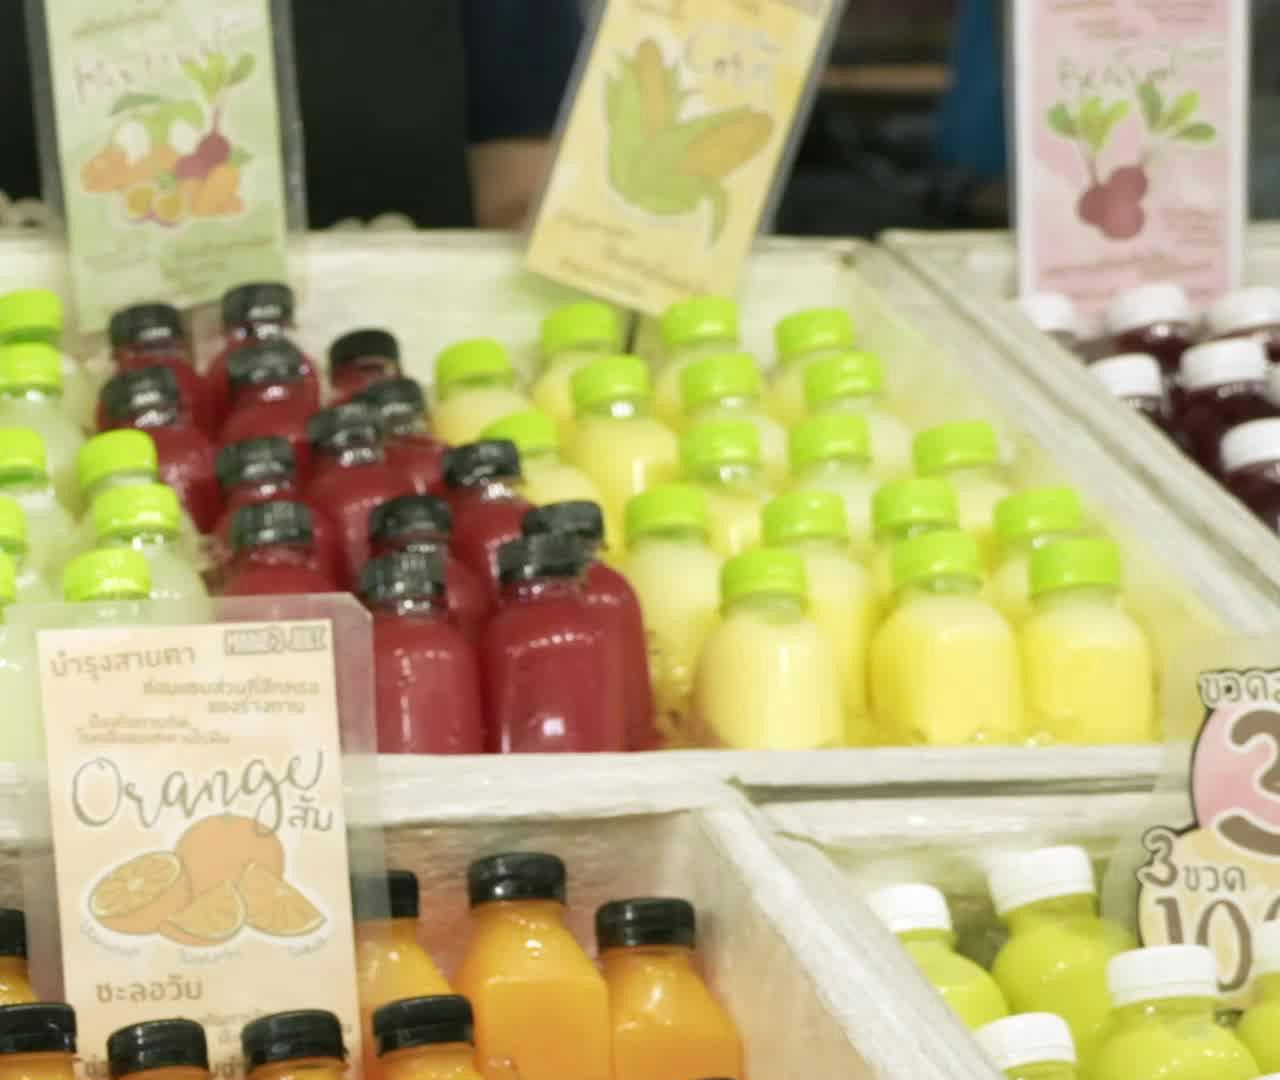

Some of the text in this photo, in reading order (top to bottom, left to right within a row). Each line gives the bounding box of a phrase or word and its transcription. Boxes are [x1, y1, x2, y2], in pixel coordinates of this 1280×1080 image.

[71, 750, 324, 838] Orange
[1142, 832, 1247, 892] 3 ขวด
